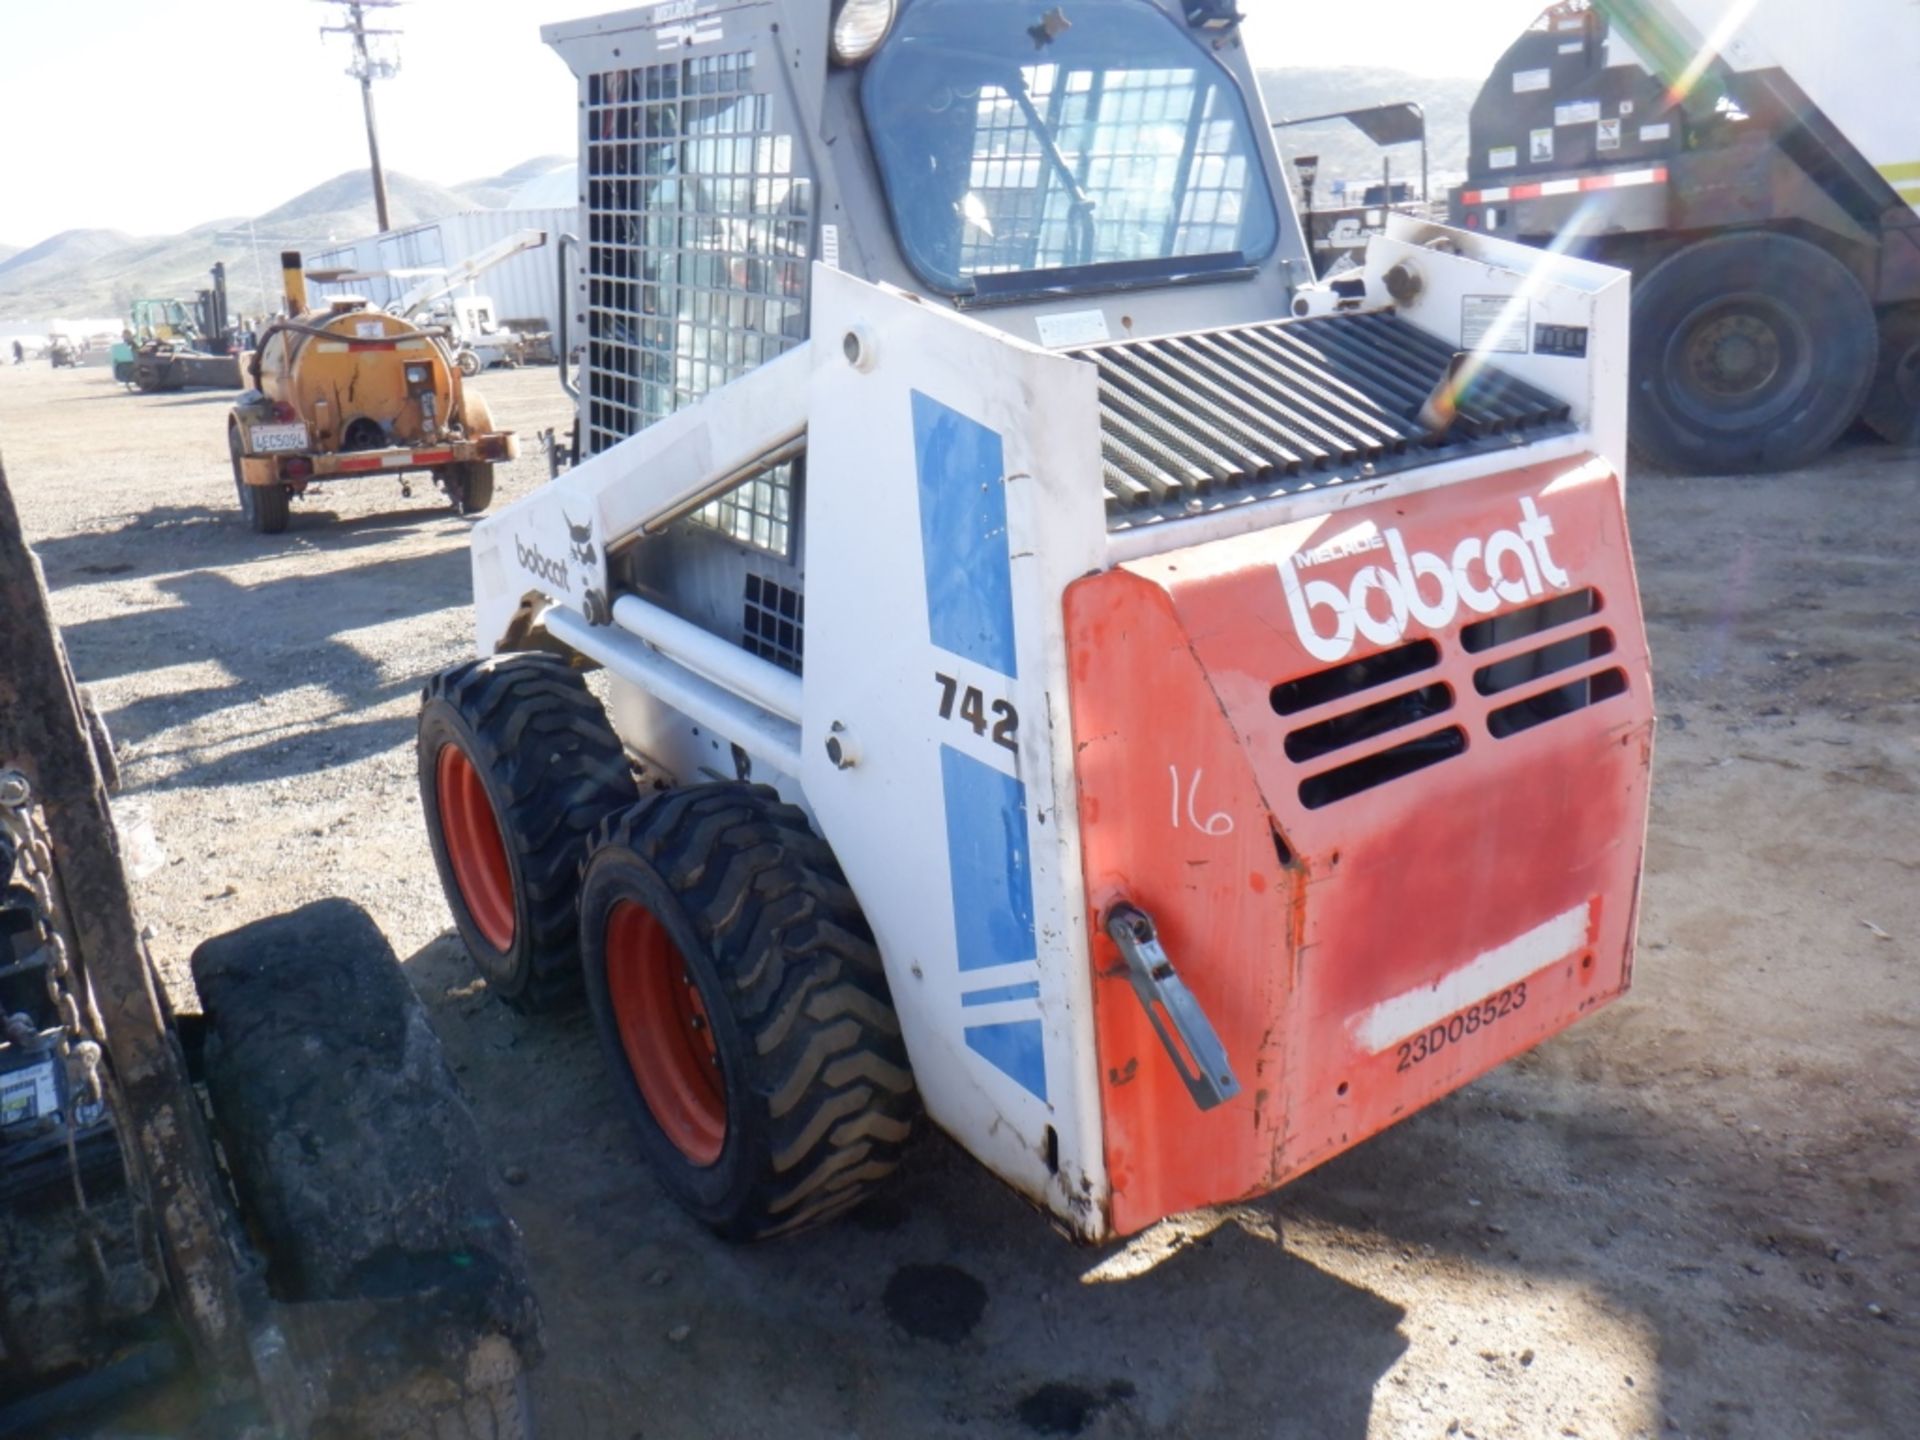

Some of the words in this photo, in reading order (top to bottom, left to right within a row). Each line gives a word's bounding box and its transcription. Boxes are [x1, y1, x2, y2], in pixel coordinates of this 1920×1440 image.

[514, 532, 571, 593] bobcat
[1276, 495, 1570, 662] bobcat
[1294, 532, 1387, 569] MELROE
[935, 670, 1019, 754] 742
[1169, 763, 1235, 836] 16
[1396, 982, 1527, 1074] 23D08523
